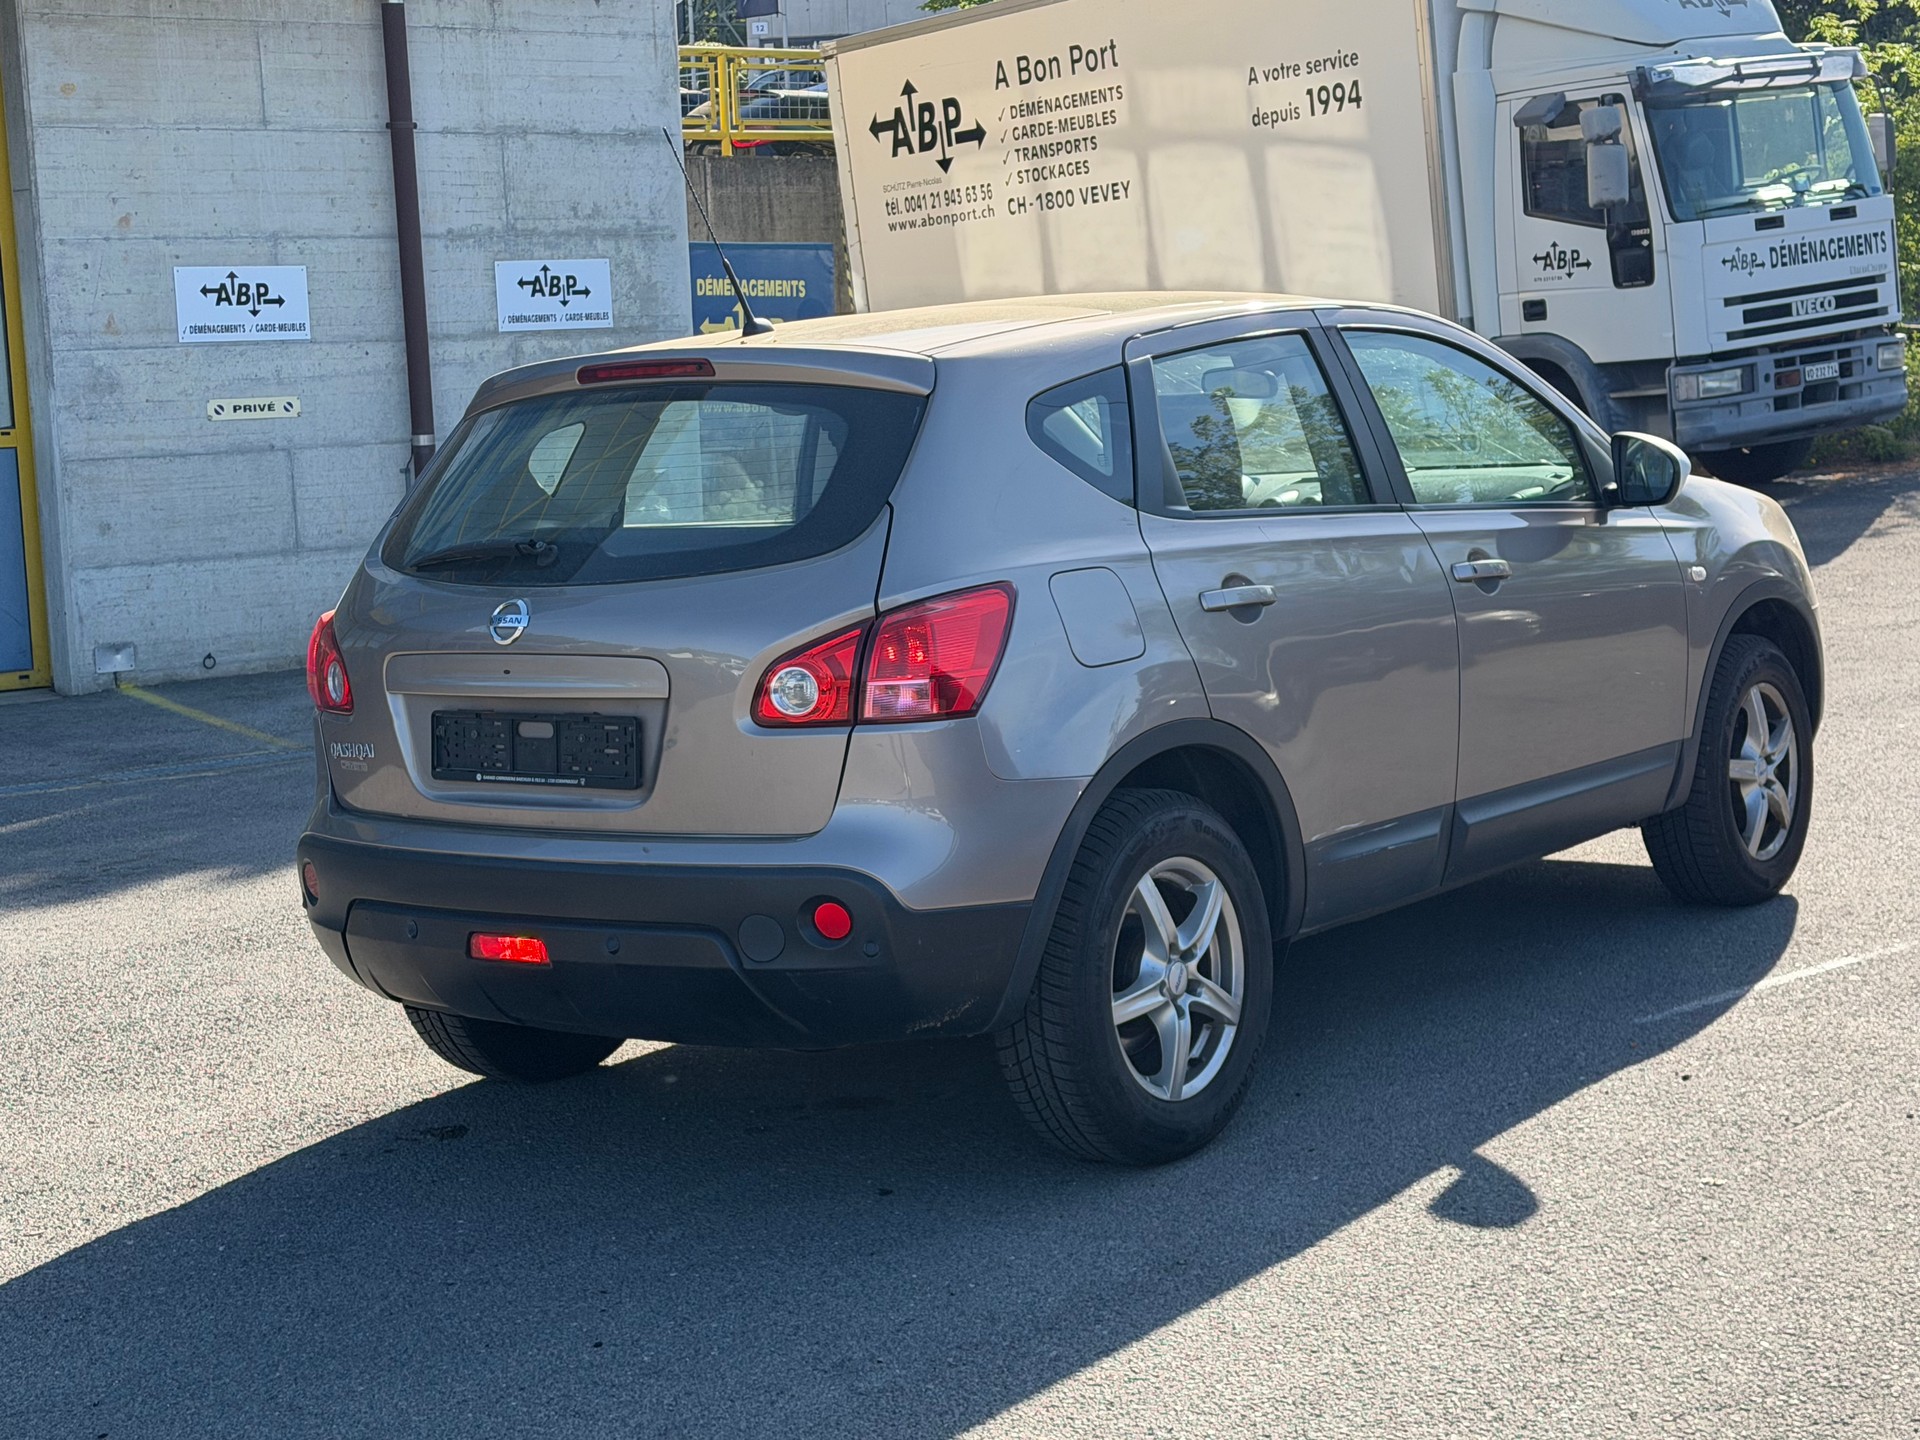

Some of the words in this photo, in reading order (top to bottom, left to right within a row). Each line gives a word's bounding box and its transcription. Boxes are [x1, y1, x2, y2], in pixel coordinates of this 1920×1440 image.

[755, 24, 765, 32] 12
[994, 60, 1010, 90] A
[1016, 55, 1061, 86] Bon
[1068, 39, 1119, 76] Port
[1248, 67, 1259, 86] A
[1262, 62, 1301, 82] votre
[1306, 49, 1359, 75] service
[1010, 85, 1124, 120] DÉMÉNAGEMENTS
[1251, 102, 1301, 129] depuis
[1306, 79, 1362, 117] 1994
[1012, 109, 1117, 141] GARDE-MEUBLES
[1014, 135, 1098, 163] TRANSPORTS
[1017, 159, 1090, 185] STOCKAGES
[885, 197, 904, 217] tél.
[904, 193, 928, 214] 0041
[930, 190, 942, 209] 21
[944, 187, 963, 208] 943
[965, 185, 978, 203] 63
[980, 182, 993, 201] 56
[1080, 180, 1131, 206] VEVEY
[888, 204, 996, 232] www.abonport.ch
[1769, 230, 1887, 269] DÉMÉNAGEMENTS
[215, 282, 269, 307] ABP
[530, 274, 578, 298] ABP
[696, 274, 806, 298] DÉMÉAGEMENTS
[564, 311, 610, 322] GARDE-MEUBLES
[1791, 295, 1837, 318] IVECO
[189, 323, 246, 335] DÉMÉNAGEMENTS
[255, 322, 307, 333] GARDE-MEUBLES
[232, 401, 276, 413] PRIVÉ
[330, 743, 375, 760] QASHQAI
